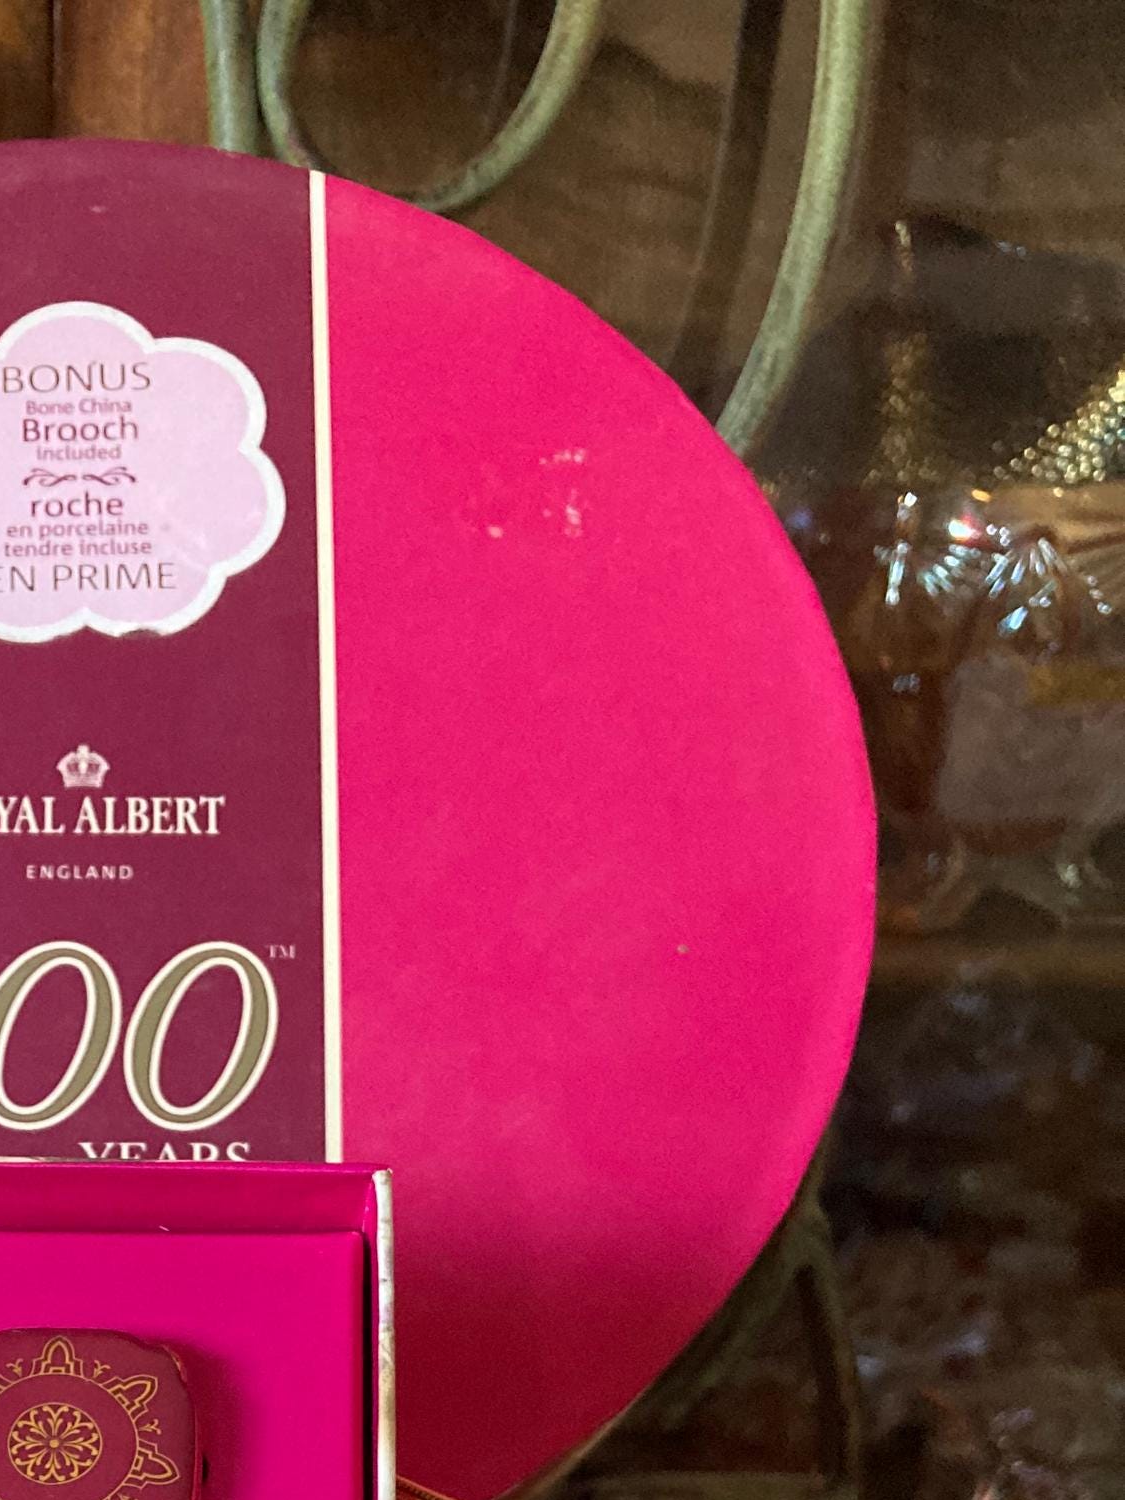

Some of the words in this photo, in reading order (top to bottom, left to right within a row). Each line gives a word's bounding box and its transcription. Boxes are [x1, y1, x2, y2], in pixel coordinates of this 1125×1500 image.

[2, 361, 152, 394] BONUS
[25, 400, 75, 415] Bone
[78, 398, 133, 414] China
[22, 415, 139, 442] Brooch
[36, 445, 123, 461] included
[30, 491, 125, 518] roche
[6, 525, 33, 538] en
[38, 520, 149, 540] porcelaine
[4, 540, 74, 557] tendre
[79, 539, 153, 556] incluse
[52, 562, 178, 591] PRIME
[74, 795, 226, 836] ALBERT
[26, 864, 135, 880] ENGLAND
